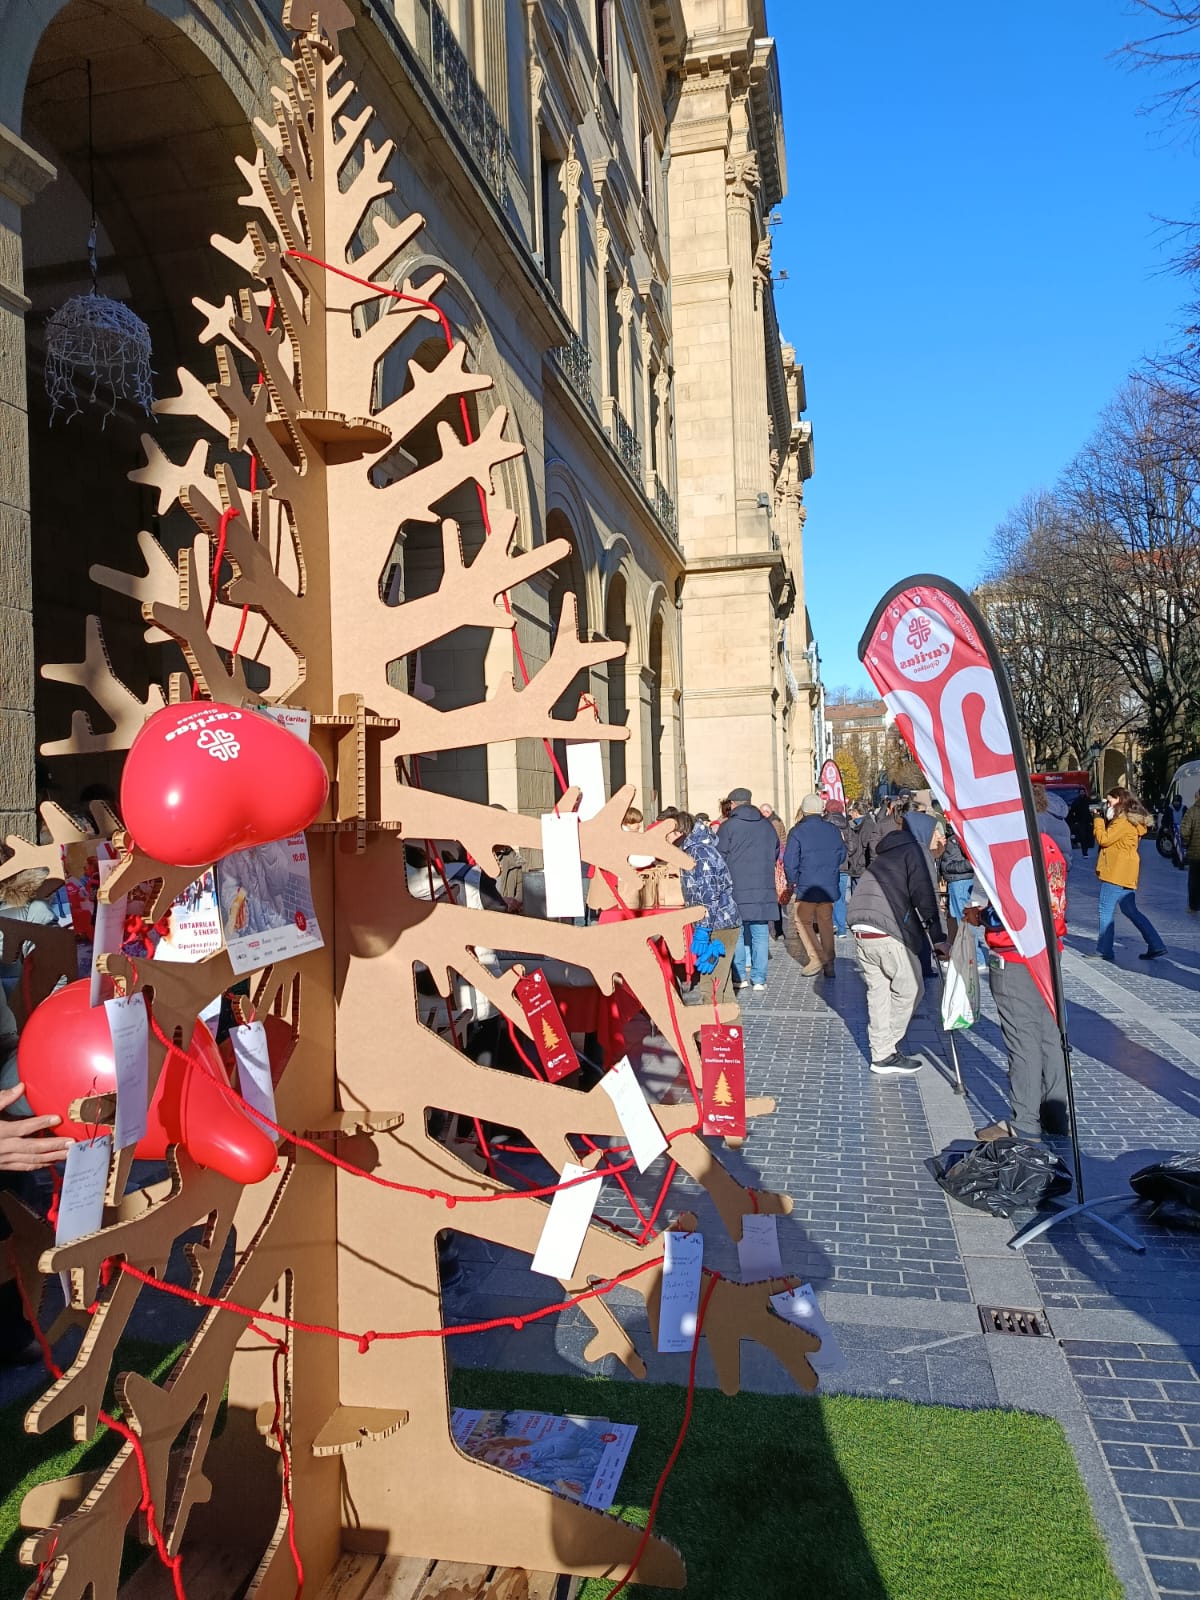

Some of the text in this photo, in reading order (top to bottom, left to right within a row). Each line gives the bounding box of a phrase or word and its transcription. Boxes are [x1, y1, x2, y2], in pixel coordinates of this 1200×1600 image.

[285, 714, 307, 723] Caritas
[165, 712, 242, 741] Caritas
[180, 921, 216, 930] URTARRILAK
[193, 928, 219, 937] 5 ENERO
